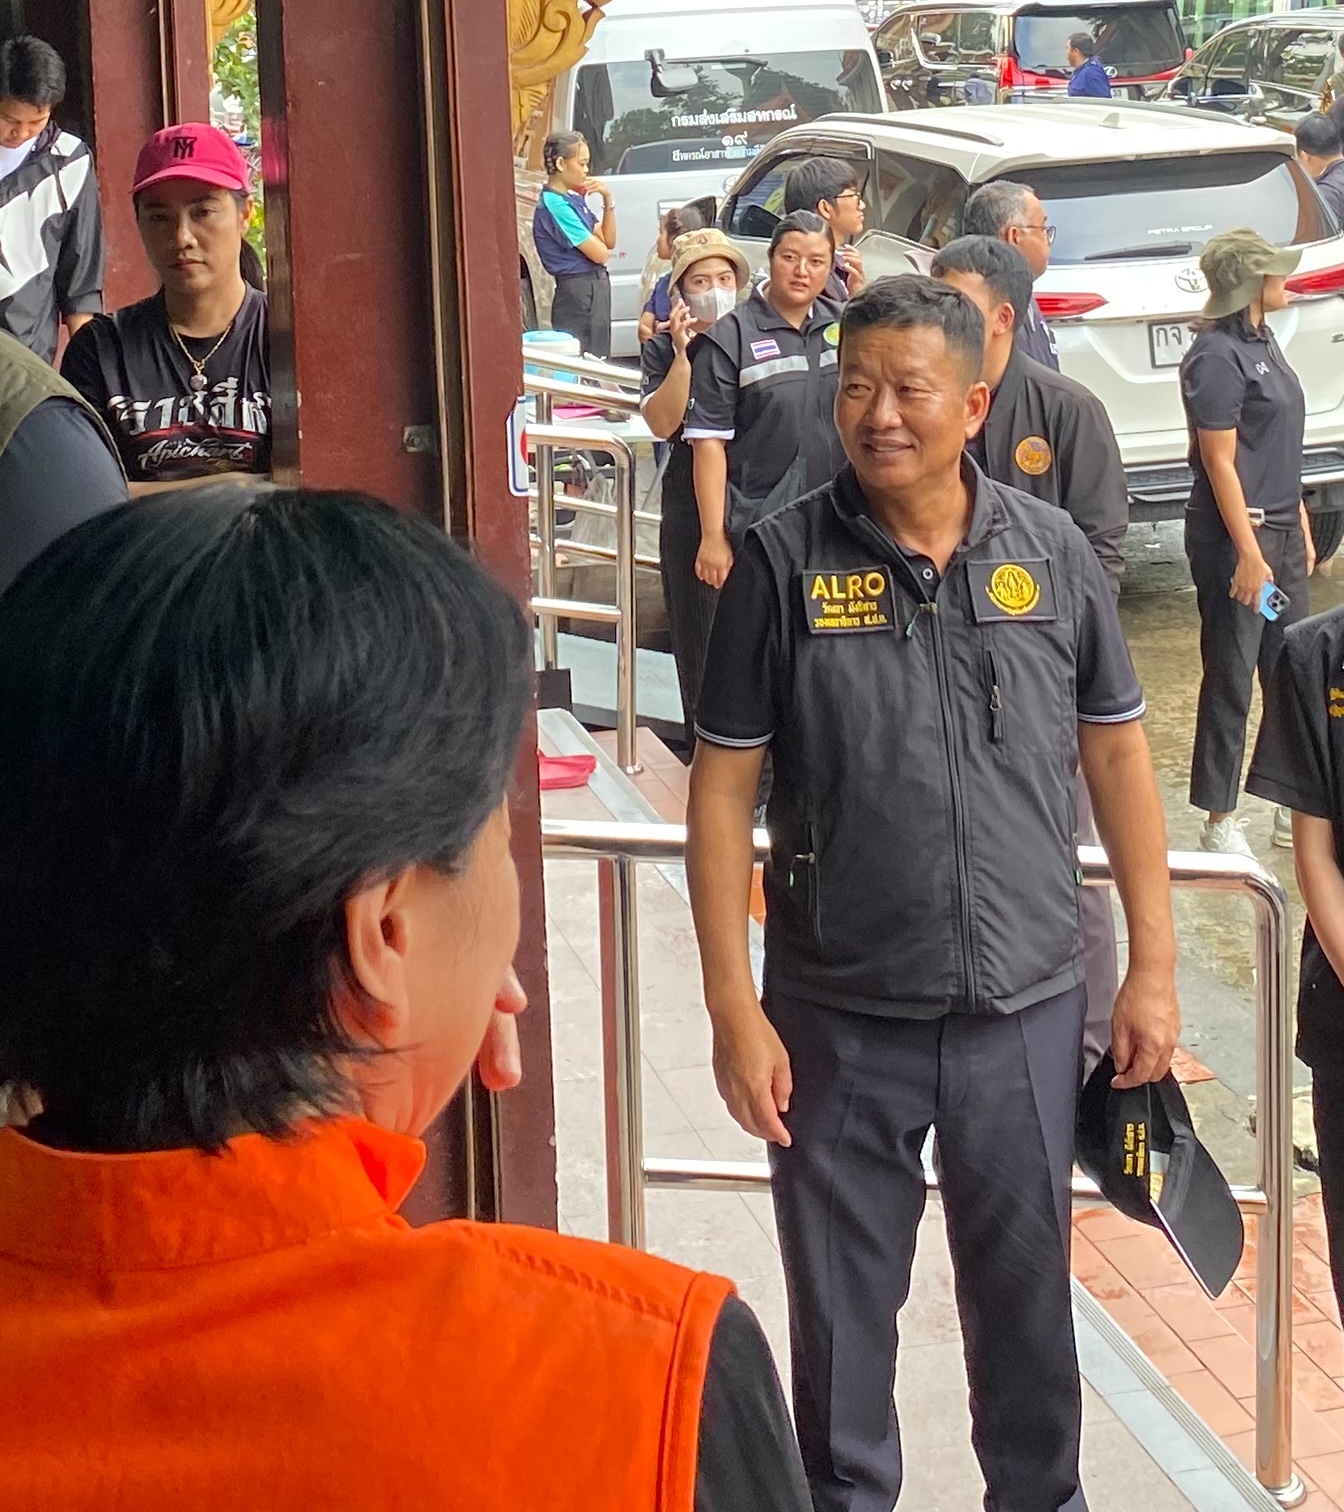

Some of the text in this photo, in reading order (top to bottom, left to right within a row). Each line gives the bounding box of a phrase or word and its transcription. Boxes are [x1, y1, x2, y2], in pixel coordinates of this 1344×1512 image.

[671, 104, 798, 127] กรมส่งเสริมสหกรณ์
[1147, 224, 1213, 236] PETRA GROUP
[811, 572, 885, 600] ALRO
